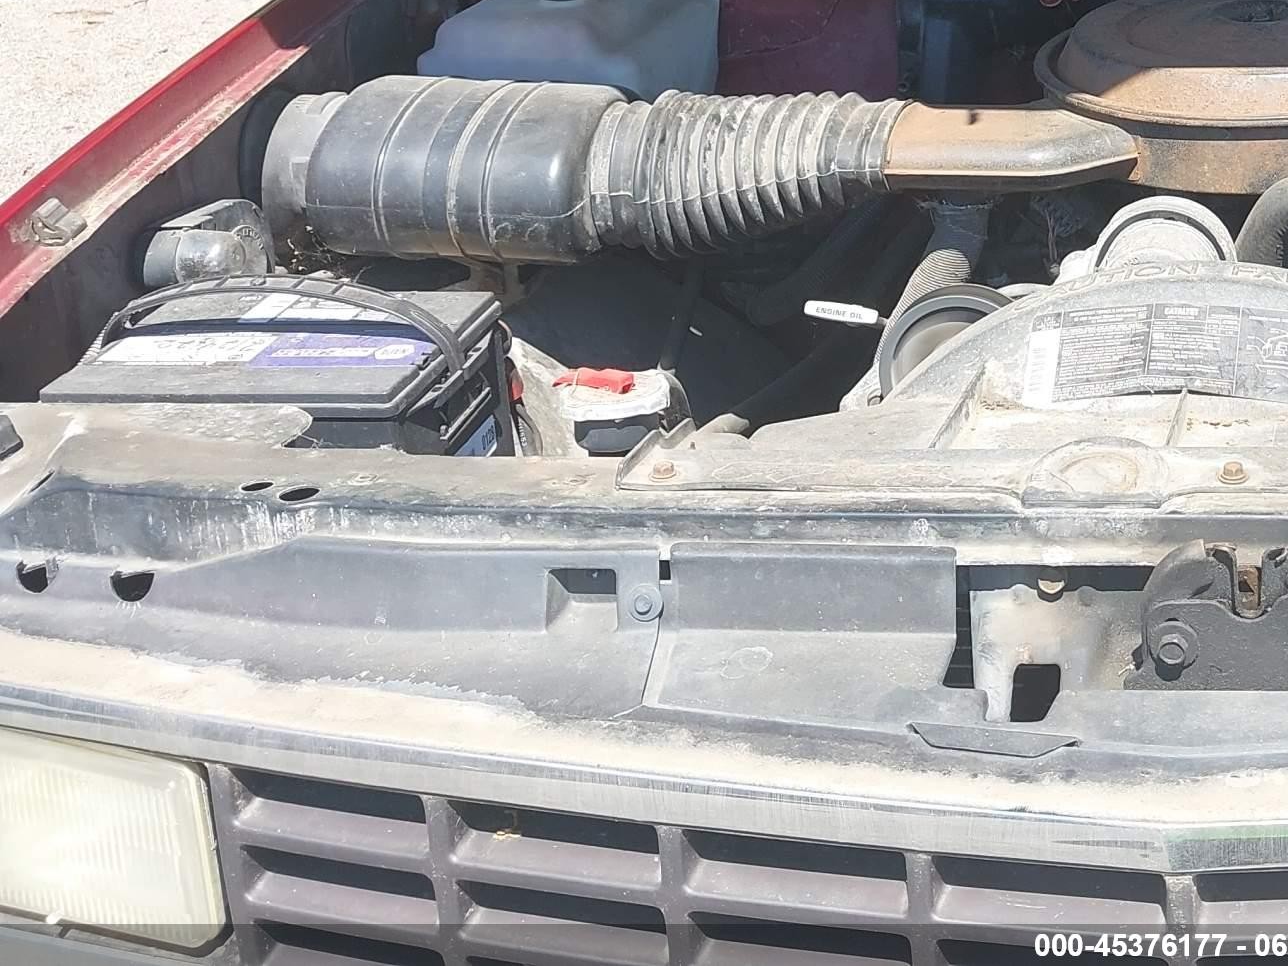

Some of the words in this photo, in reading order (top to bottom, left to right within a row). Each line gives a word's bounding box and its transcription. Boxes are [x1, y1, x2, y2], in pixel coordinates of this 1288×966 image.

[1013, 263, 1202, 312] CAUTION
[815, 306, 847, 318] ENGINE
[849, 312, 864, 320] OIL
